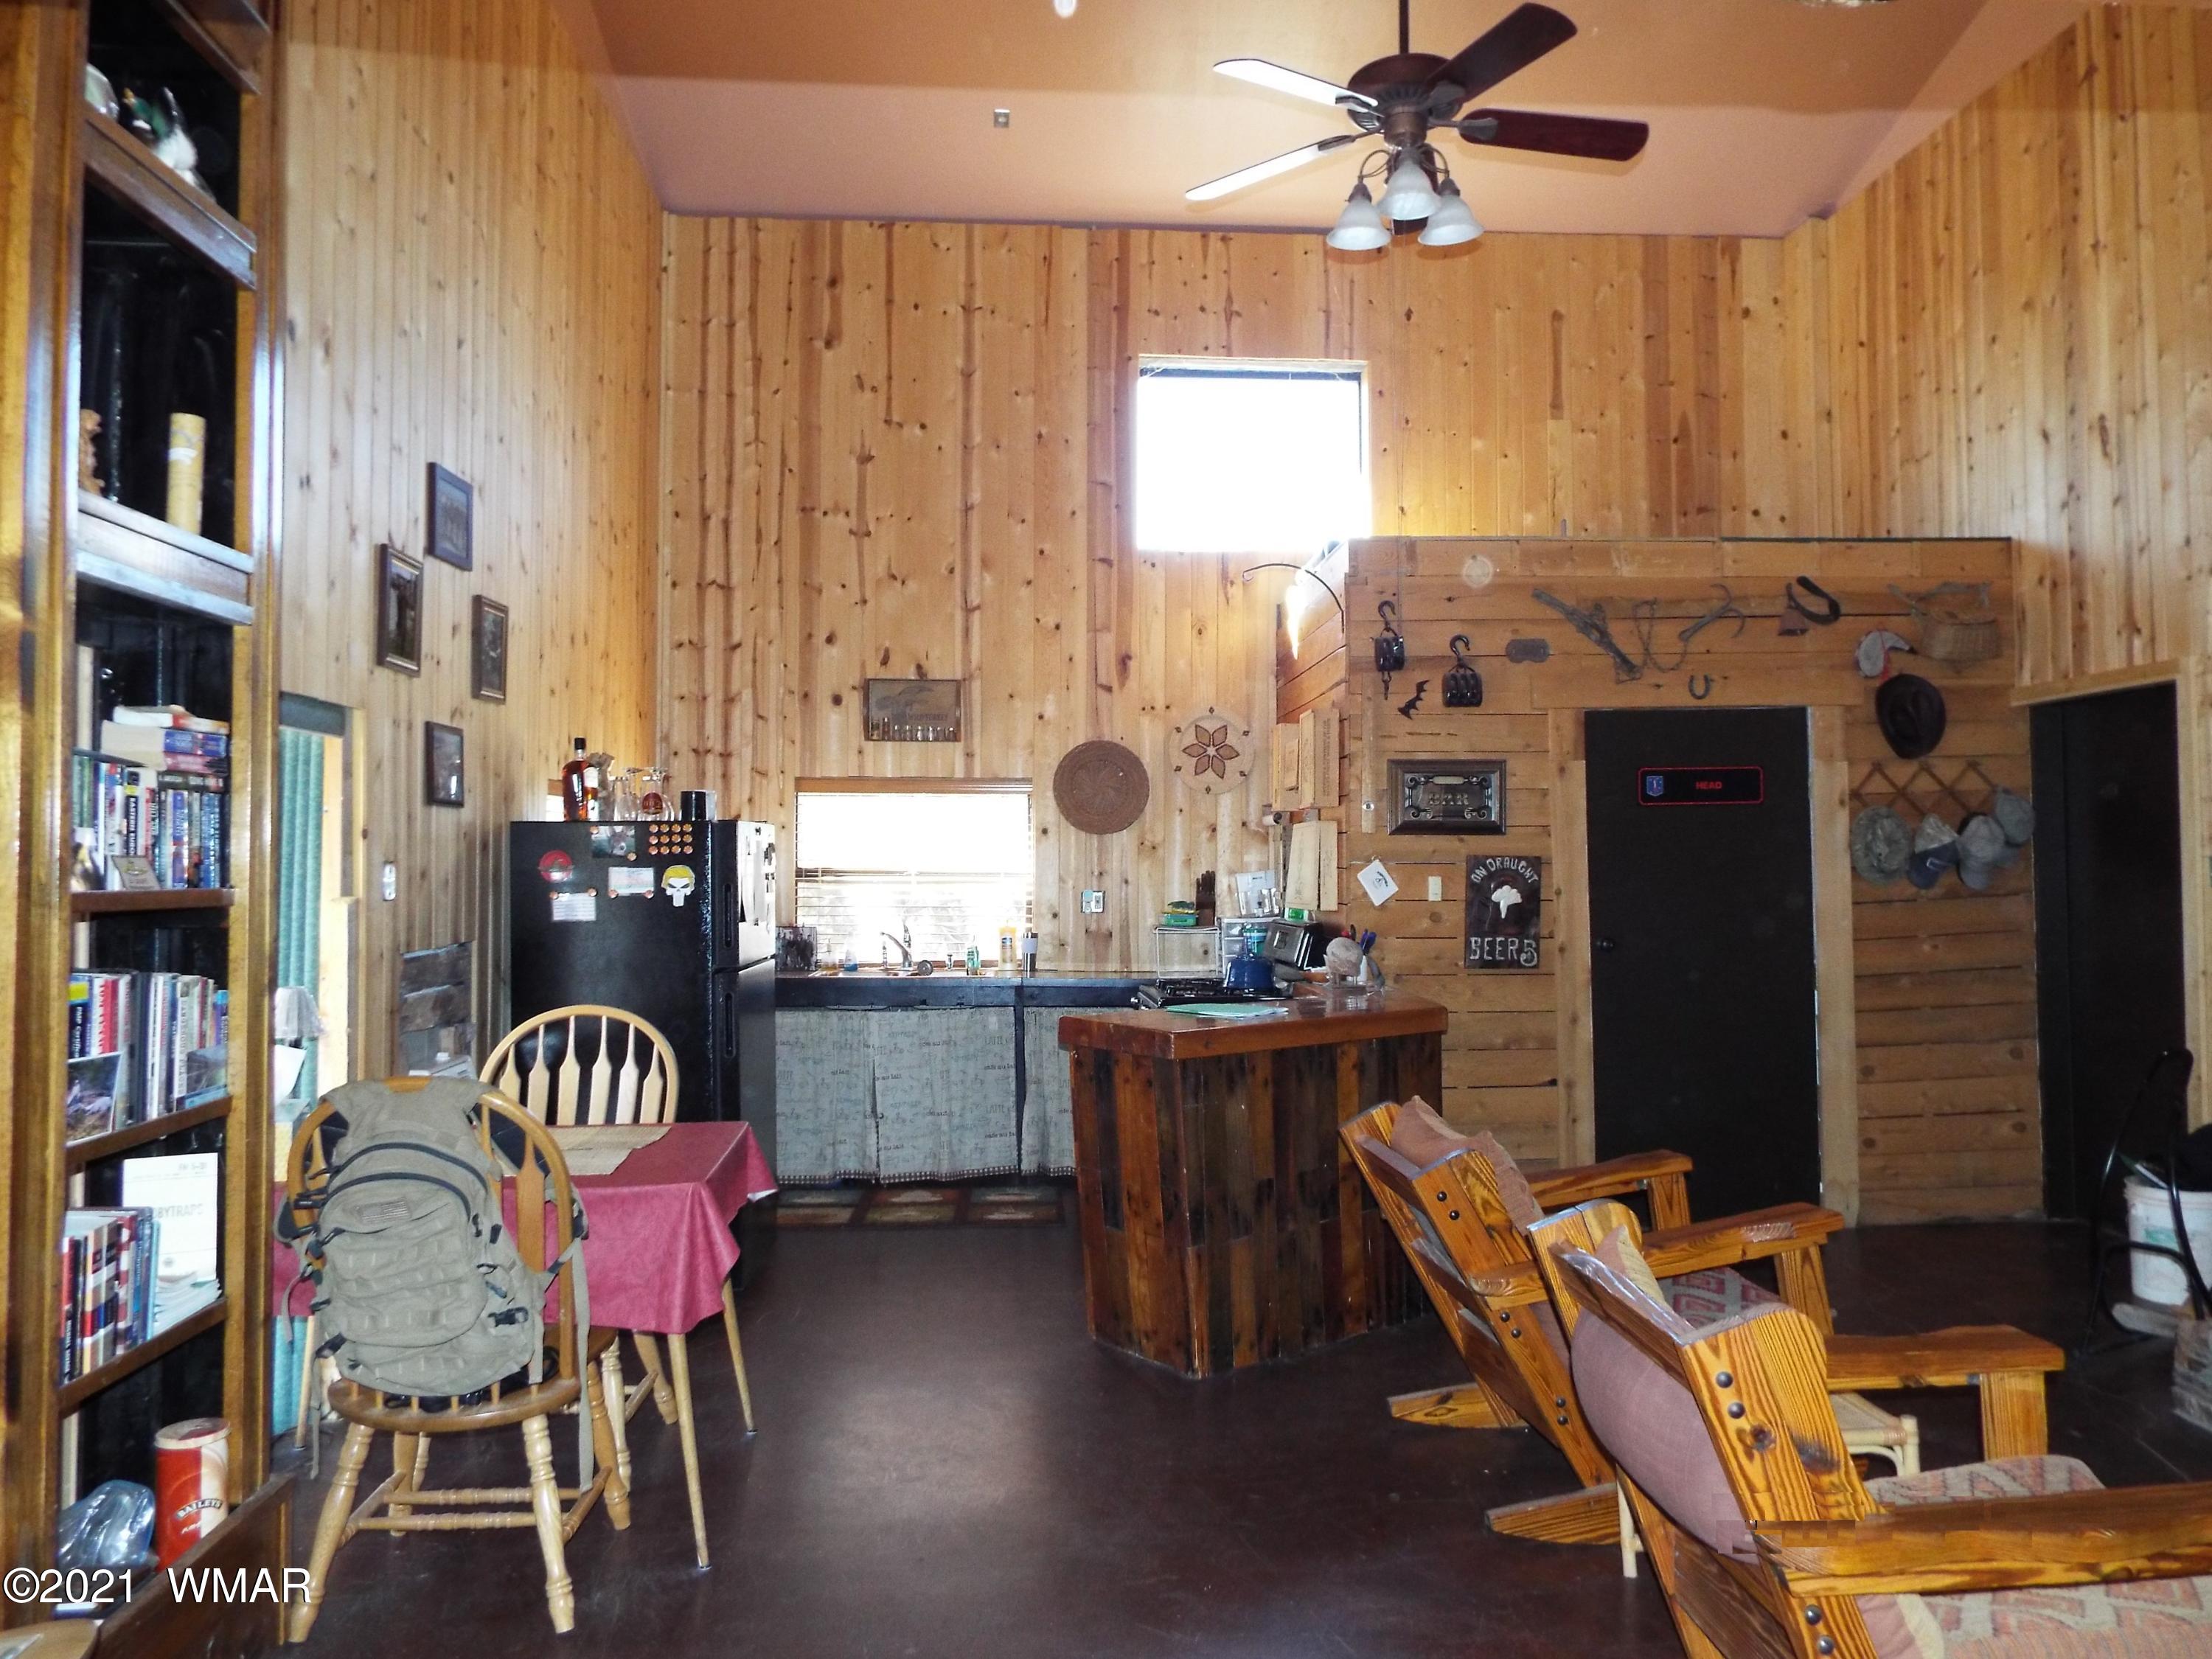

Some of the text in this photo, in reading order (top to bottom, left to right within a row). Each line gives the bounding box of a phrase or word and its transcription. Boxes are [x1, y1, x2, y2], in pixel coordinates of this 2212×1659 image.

[1696, 782, 1722, 790] HEAD
[1429, 793, 1469, 806] BAR
[1471, 857, 1539, 883] ON DRAUGHT
[1470, 937, 1537, 967] BEERS
[176, 1498, 223, 1519] BAILEYS
